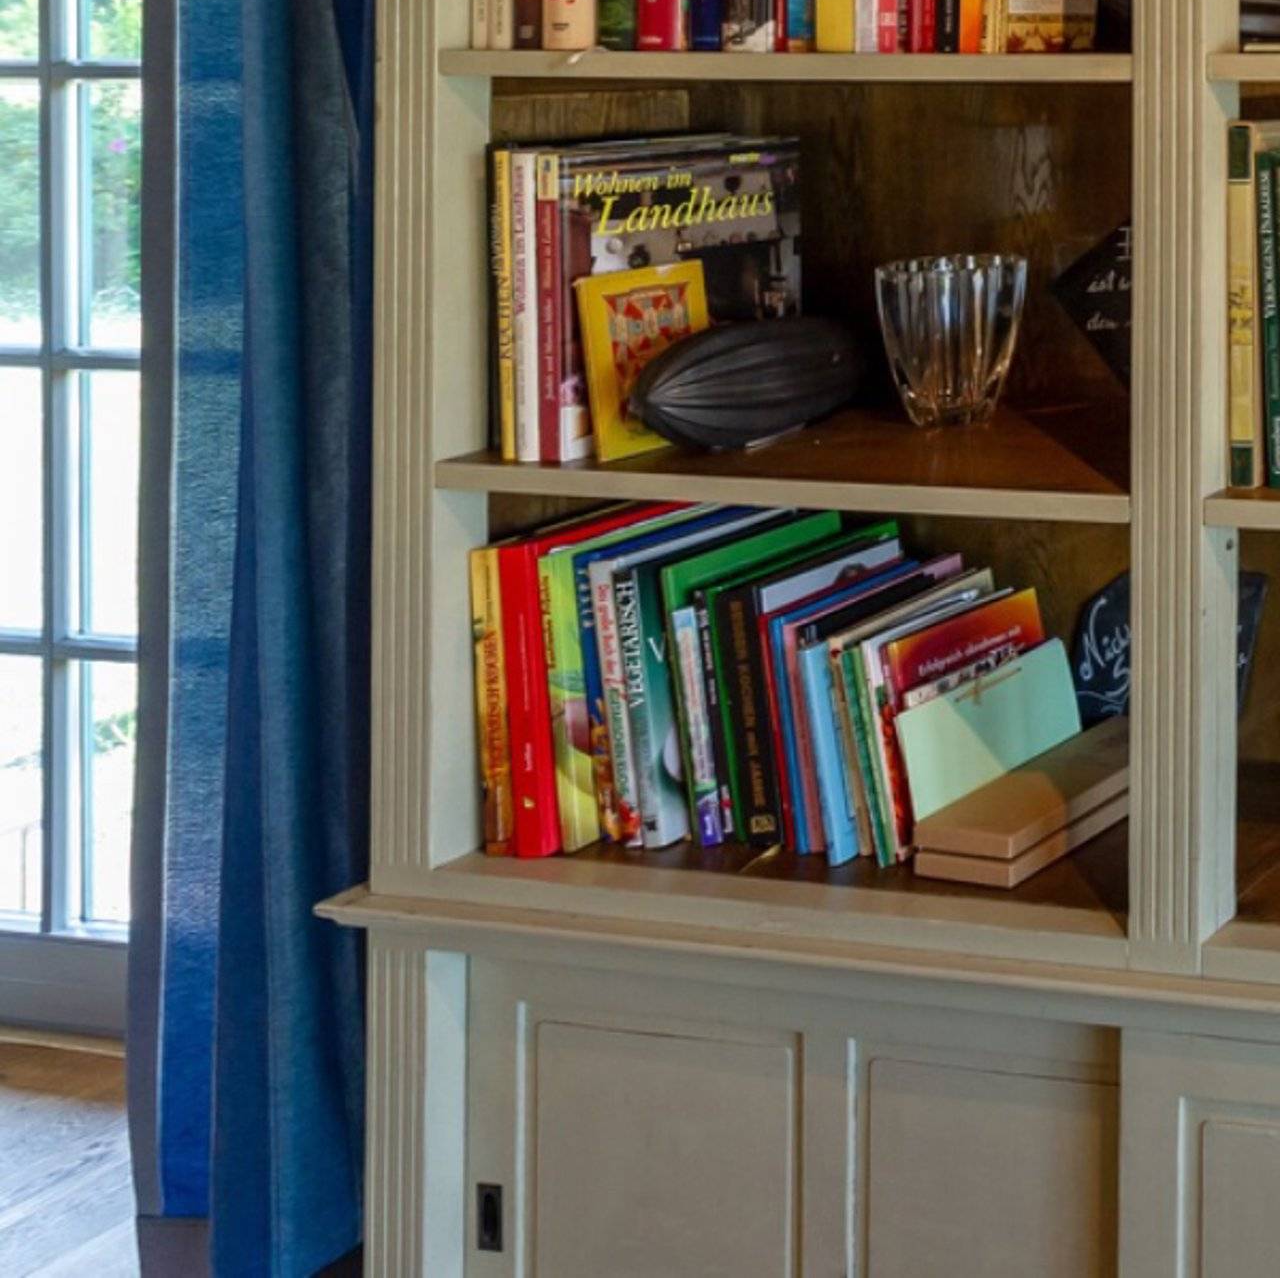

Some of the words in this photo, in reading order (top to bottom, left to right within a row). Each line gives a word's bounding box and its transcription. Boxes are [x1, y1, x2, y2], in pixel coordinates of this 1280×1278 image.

[576, 172, 658, 197] Wohnen
[667, 167, 692, 190] im
[598, 186, 774, 235] Landhaus
[612, 581, 645, 710] VEGETARISCH
